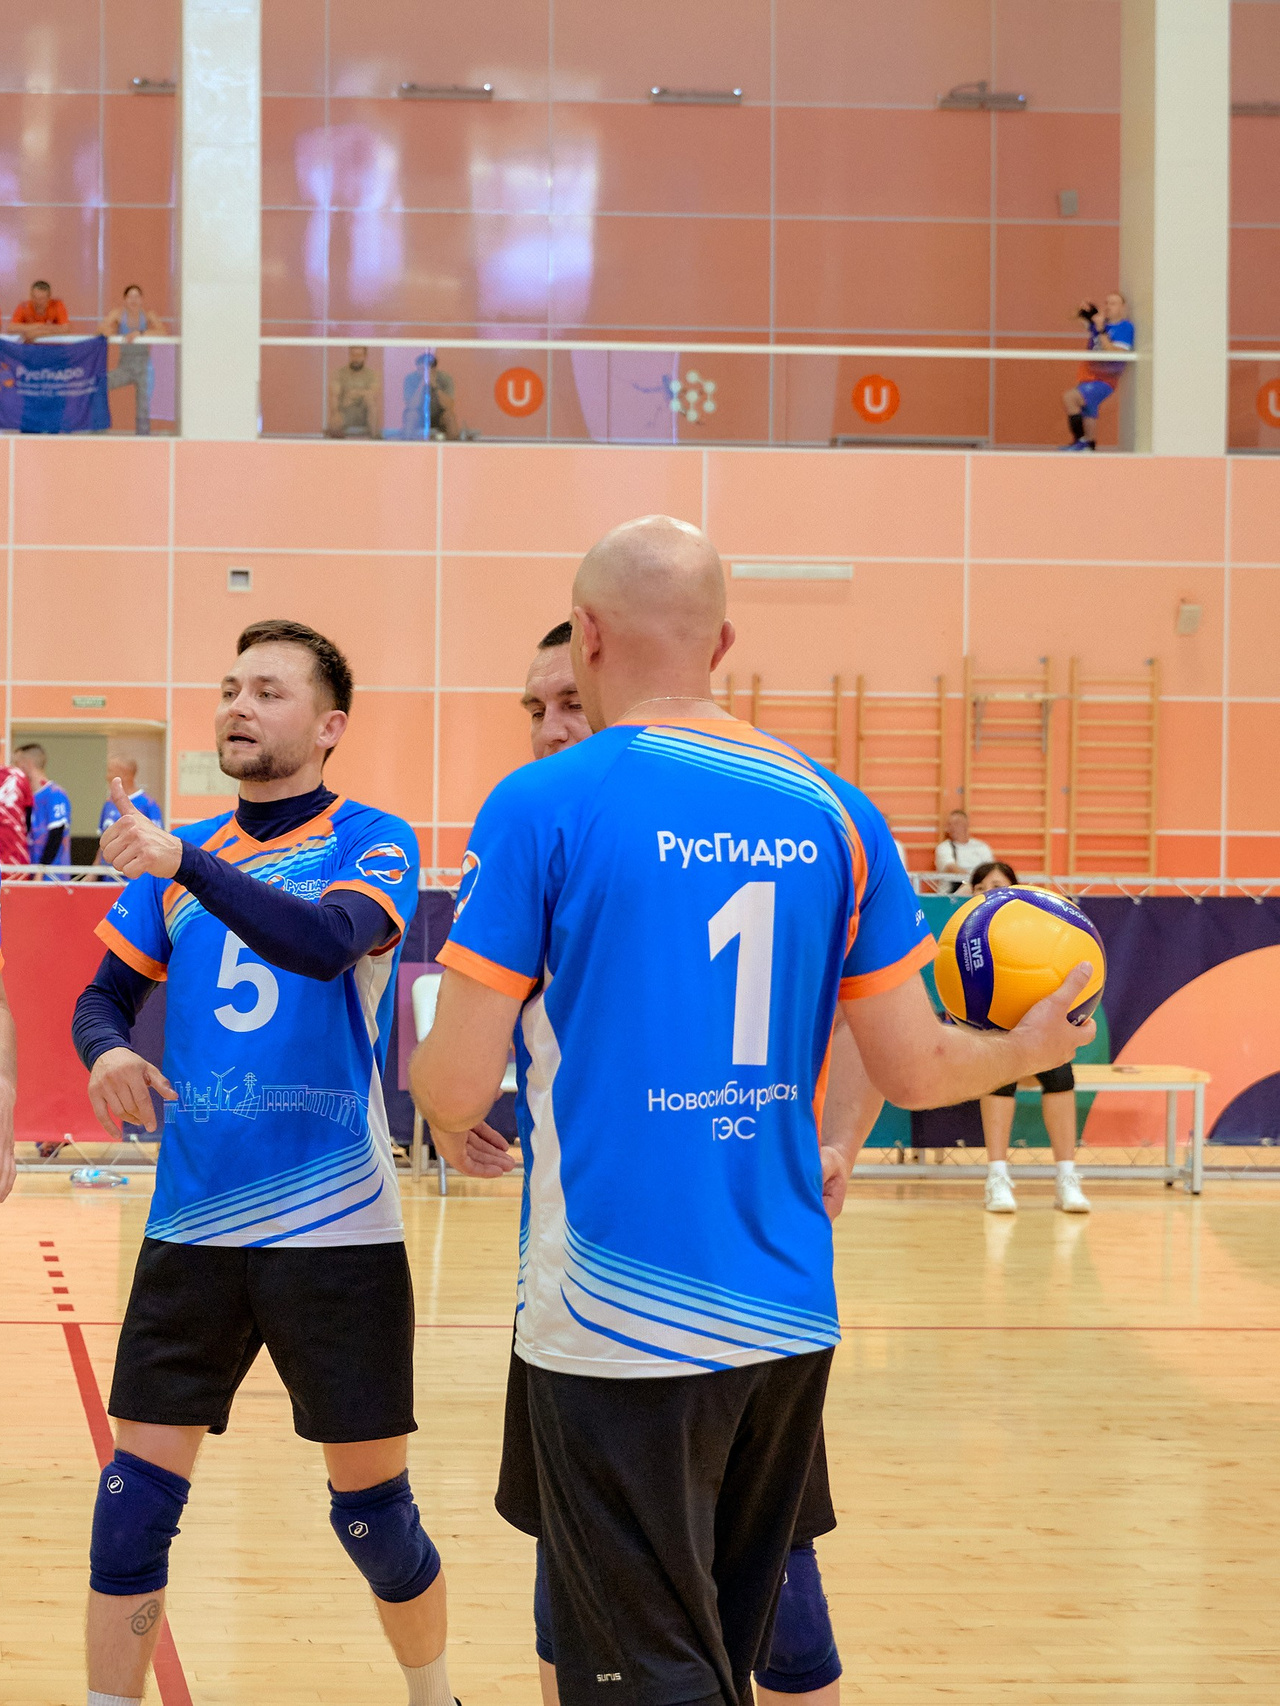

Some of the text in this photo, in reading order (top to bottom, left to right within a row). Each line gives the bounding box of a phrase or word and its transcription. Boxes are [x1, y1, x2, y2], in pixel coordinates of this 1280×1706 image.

[657, 830, 818, 869] РусГидро
[970, 937, 984, 970] FIVB
[213, 930, 280, 1033] 5
[708, 881, 776, 1066] 1
[712, 1116, 756, 1141] ГЭС
